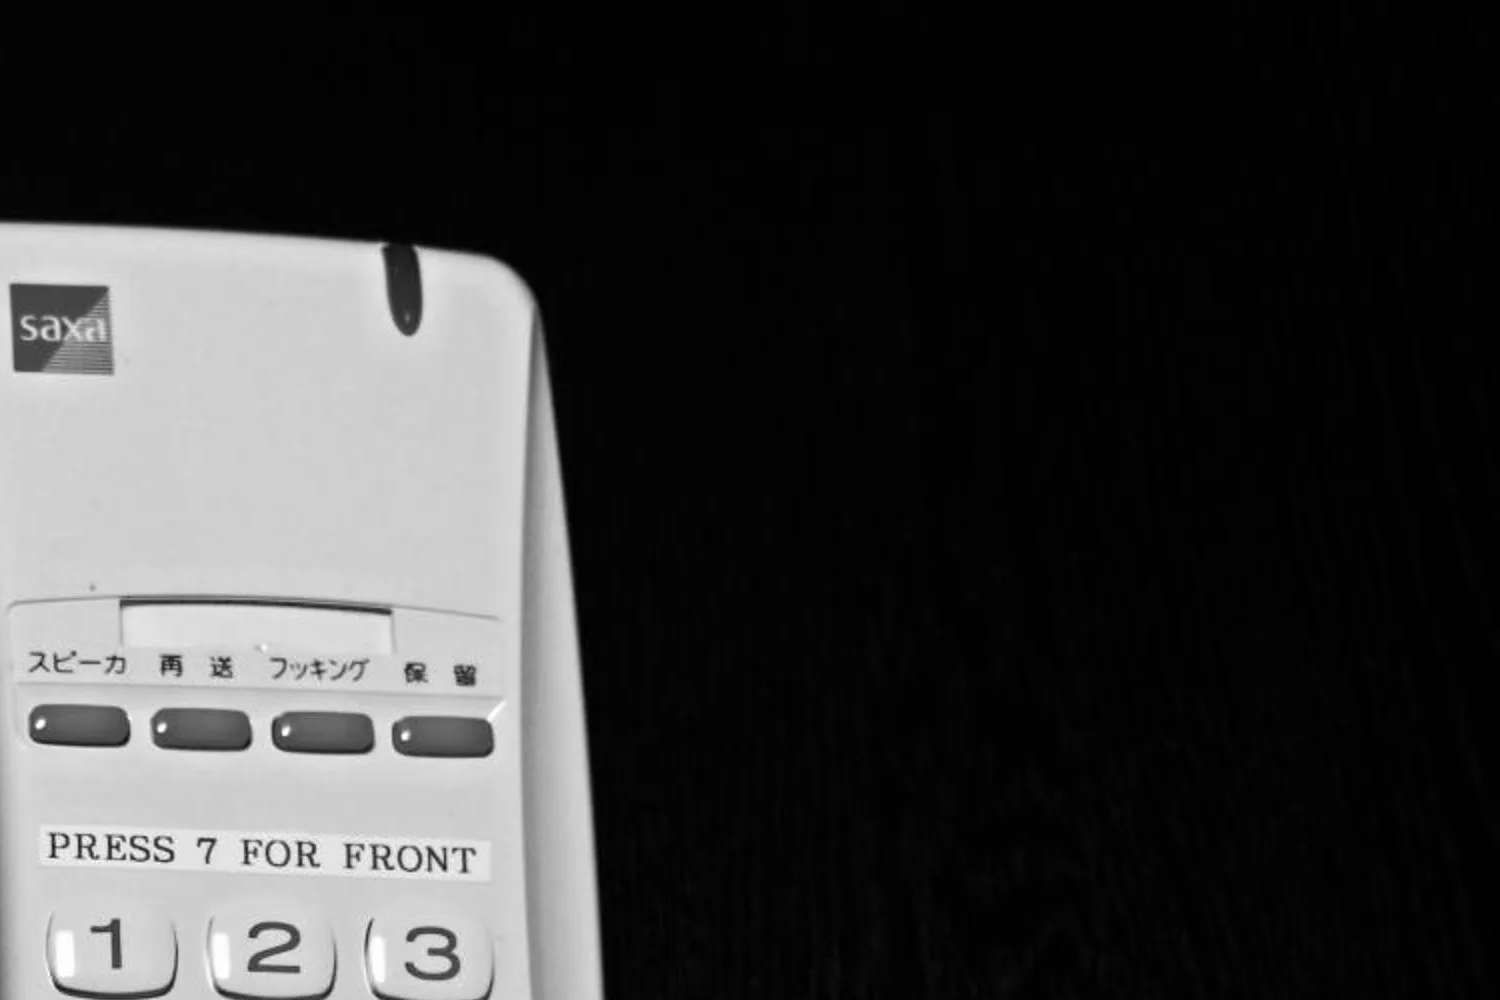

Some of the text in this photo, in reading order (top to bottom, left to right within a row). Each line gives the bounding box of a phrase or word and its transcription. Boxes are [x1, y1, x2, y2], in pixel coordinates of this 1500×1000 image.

[19, 311, 106, 343] saxa
[28, 650, 127, 675] スピーカ
[270, 657, 370, 682] フッキング
[48, 831, 477, 874] PRESS 7 FOR FRONT
[89, 918, 123, 970] 1
[247, 921, 301, 975] 2
[404, 925, 461, 981] 3
